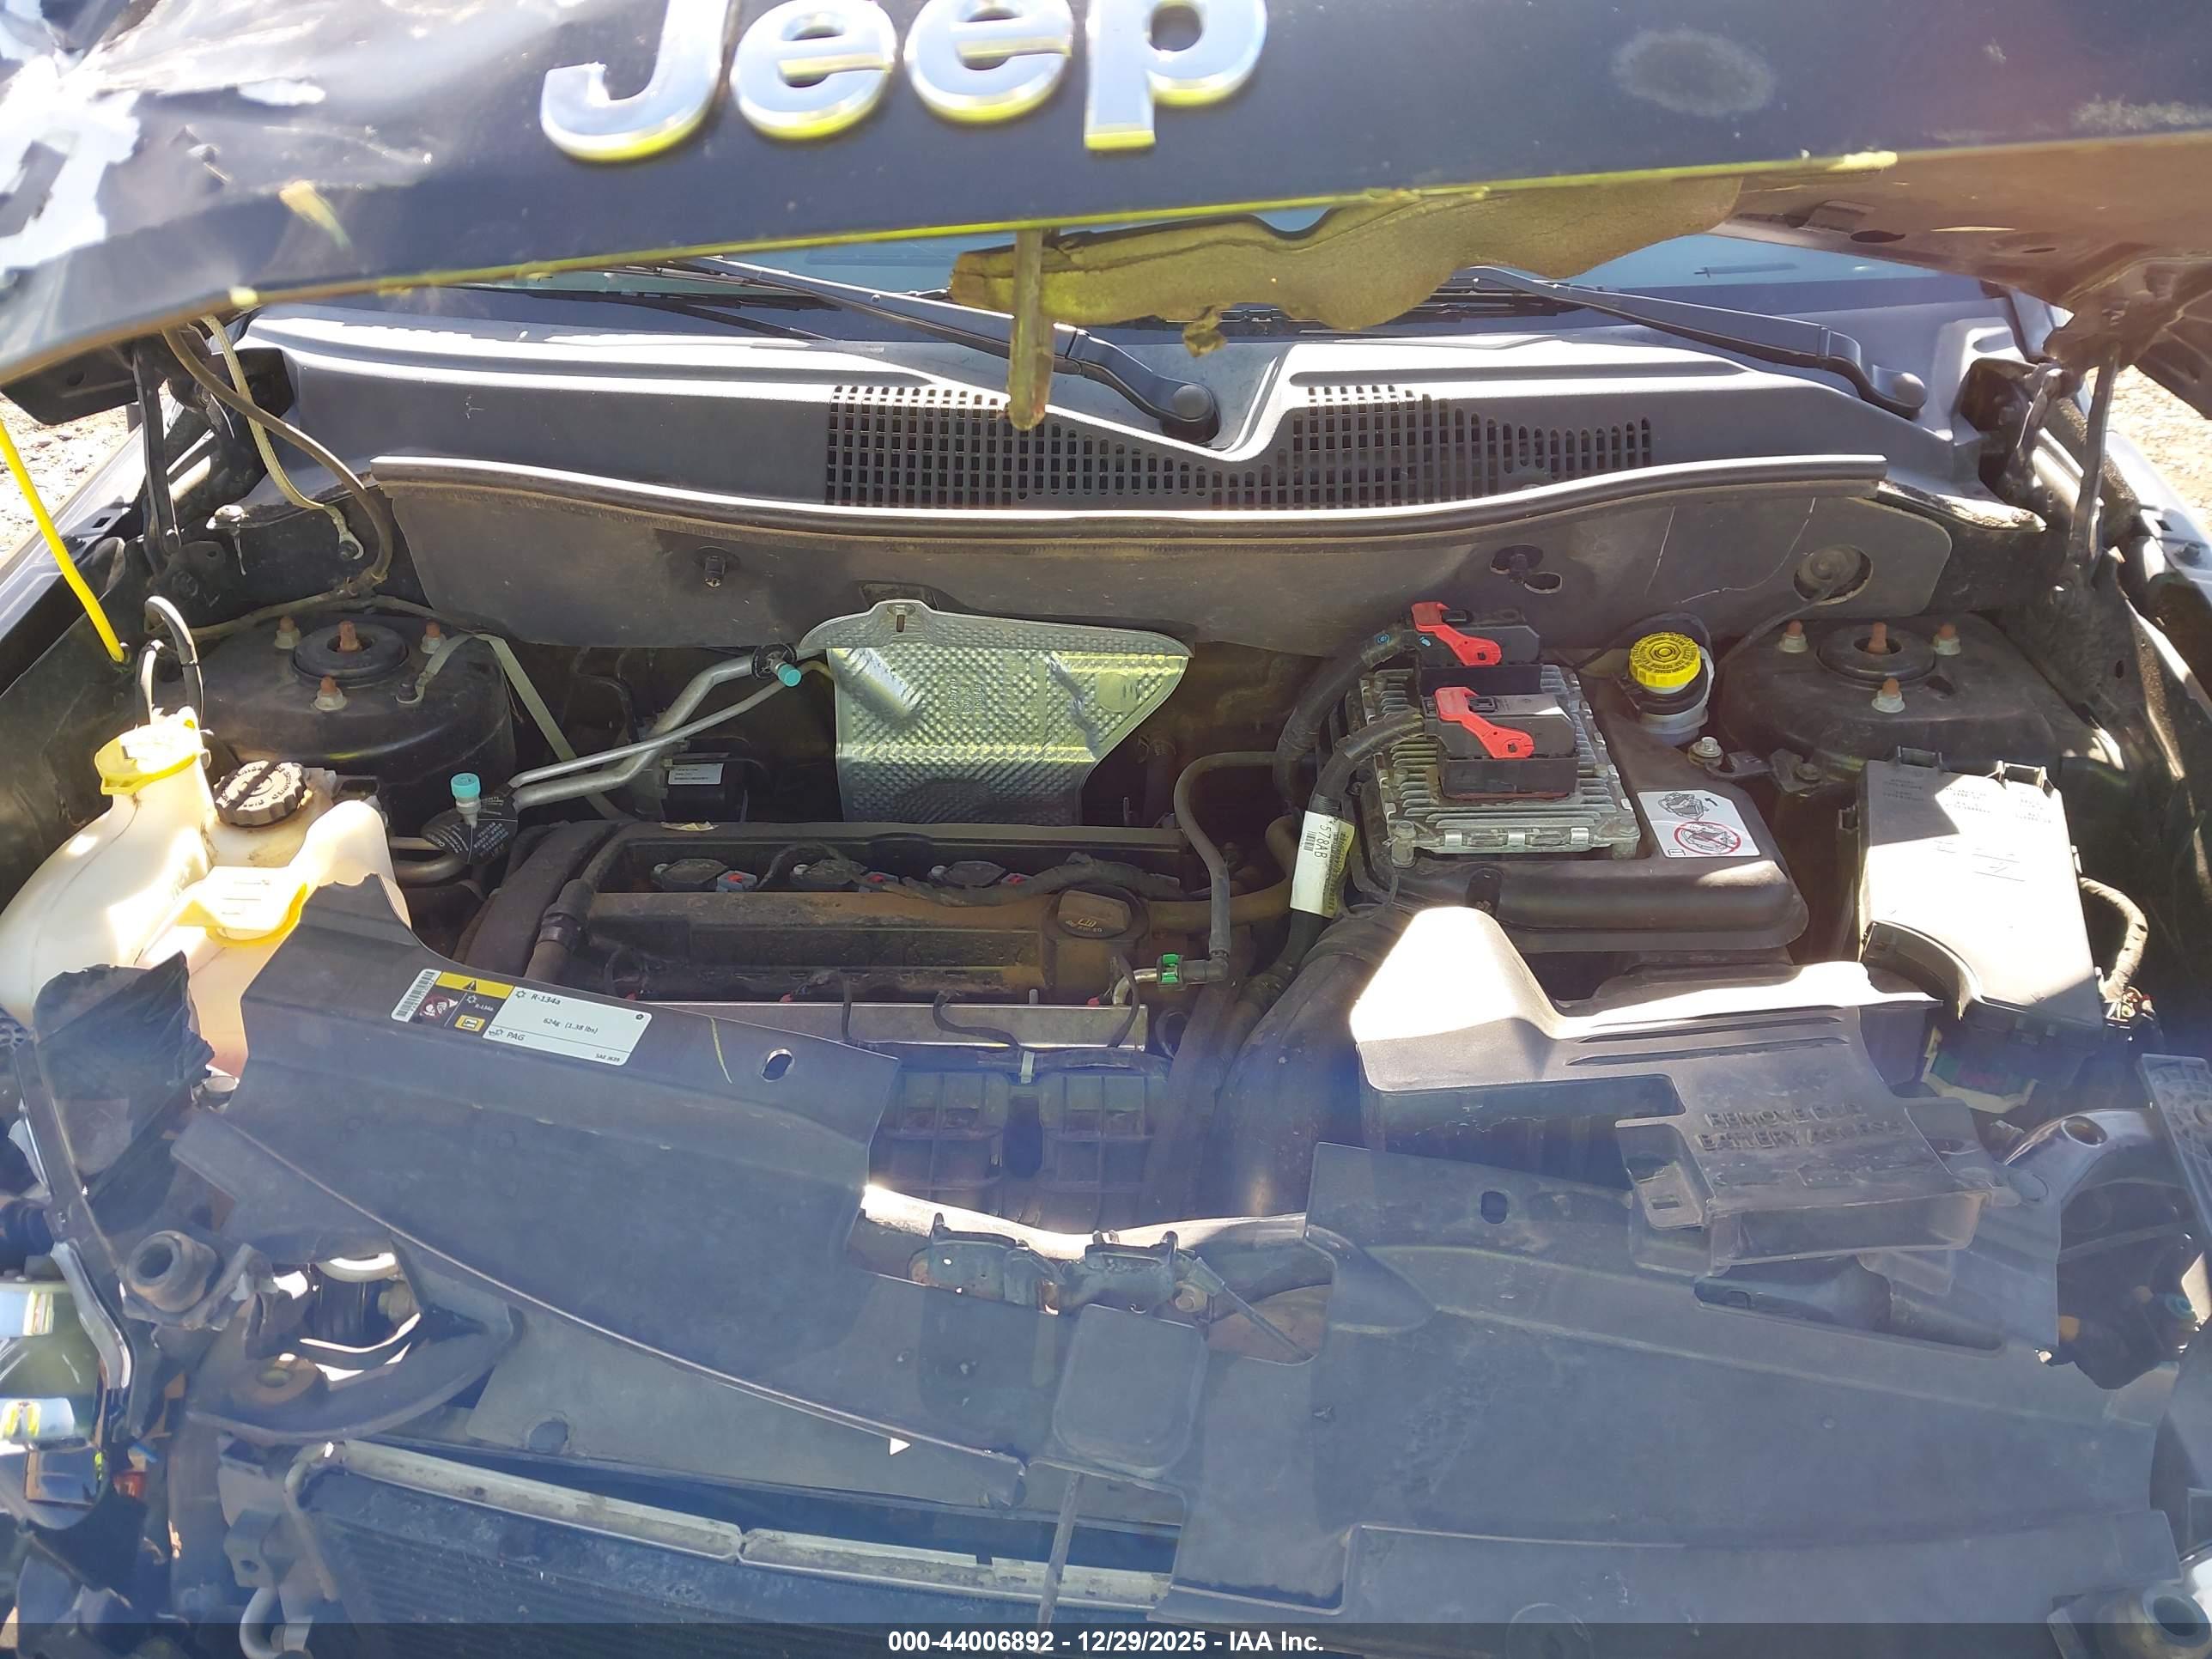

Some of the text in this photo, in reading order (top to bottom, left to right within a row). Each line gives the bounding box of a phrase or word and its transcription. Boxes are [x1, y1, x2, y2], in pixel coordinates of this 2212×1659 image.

[540, 0, 1267, 161] Jeep
[531, 994, 561, 1006] R-134a
[543, 1018, 599, 1034] 624g (1.38 lbs)
[507, 1031, 526, 1042] PAG
[1705, 1107, 1808, 1128] REMOVE
[1694, 1120, 1905, 1151] BATTERY ACCESS
